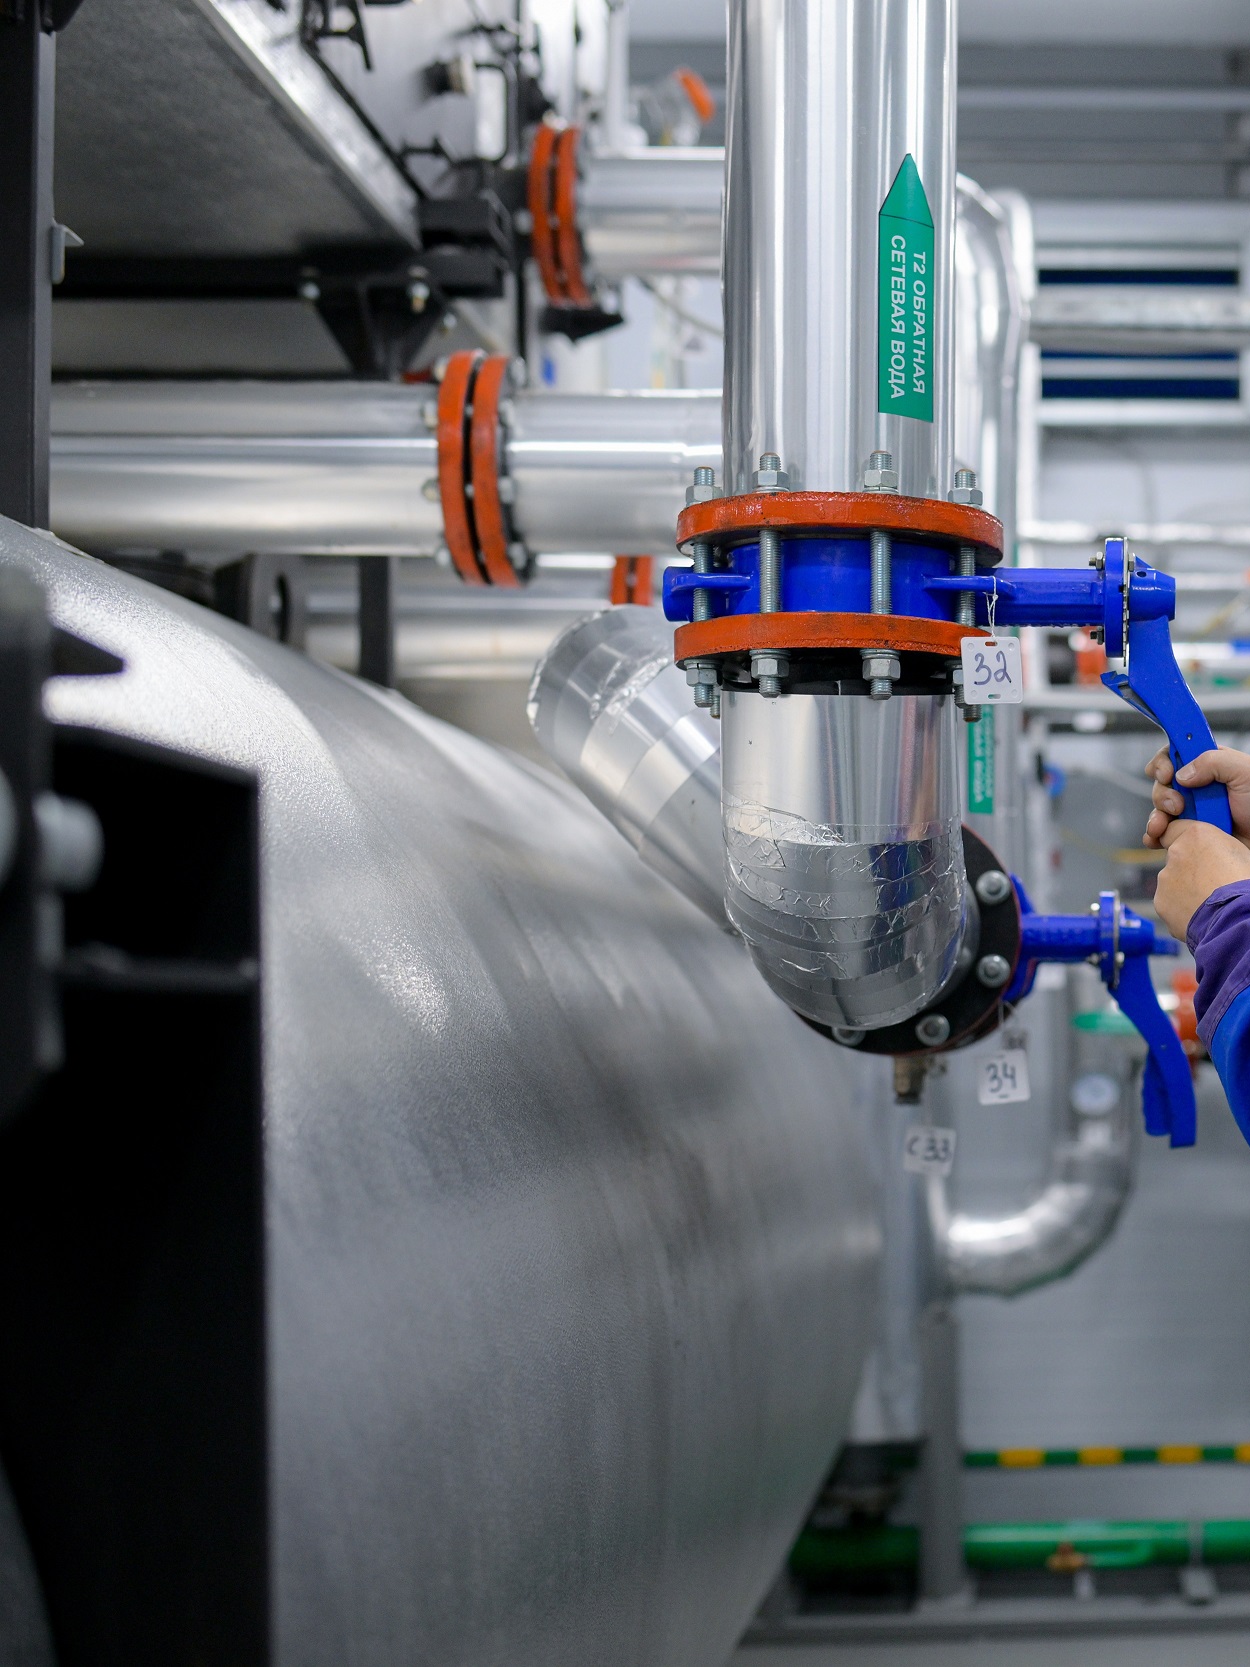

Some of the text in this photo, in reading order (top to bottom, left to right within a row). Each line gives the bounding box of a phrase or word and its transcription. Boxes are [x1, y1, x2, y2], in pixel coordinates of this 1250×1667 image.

[889, 234, 907, 399] СЕТЕВАЯ ВОДА
[912, 251, 927, 394] Т2 ОБРАТНАЯ
[973, 650, 1012, 686] 32
[985, 1061, 1018, 1094] 34
